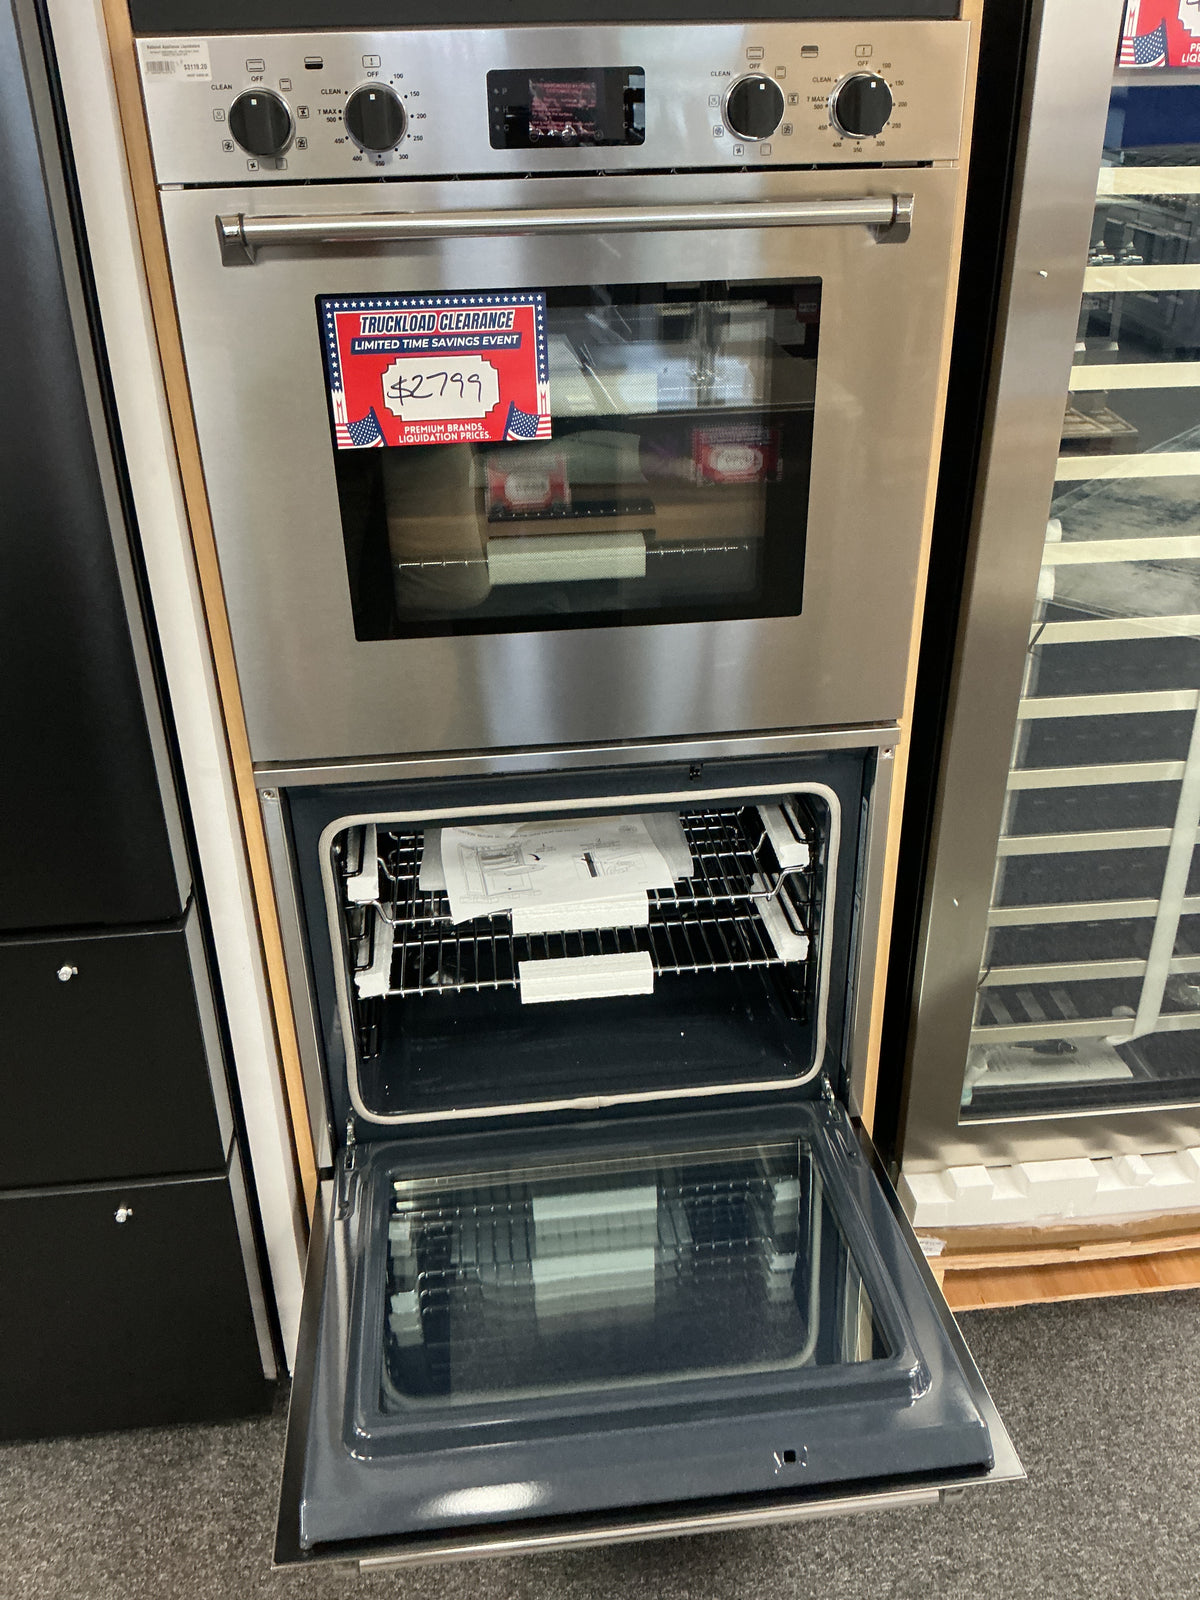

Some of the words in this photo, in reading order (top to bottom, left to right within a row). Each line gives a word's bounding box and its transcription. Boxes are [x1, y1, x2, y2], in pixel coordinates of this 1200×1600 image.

[360, 313, 437, 335] TRUCKLOAD
[438, 310, 515, 333] CLEARANCE
[354, 339, 400, 350] LIMITED
[402, 338, 429, 348] TIME
[431, 336, 480, 347] SAVINGS
[482, 335, 519, 345] EVENT
[387, 371, 482, 406] $2799
[404, 424, 446, 433] PREMIUM
[447, 422, 485, 432] BRANDS.
[398, 433, 458, 443] LIQUIDATION
[460, 431, 492, 440] PRICES.
